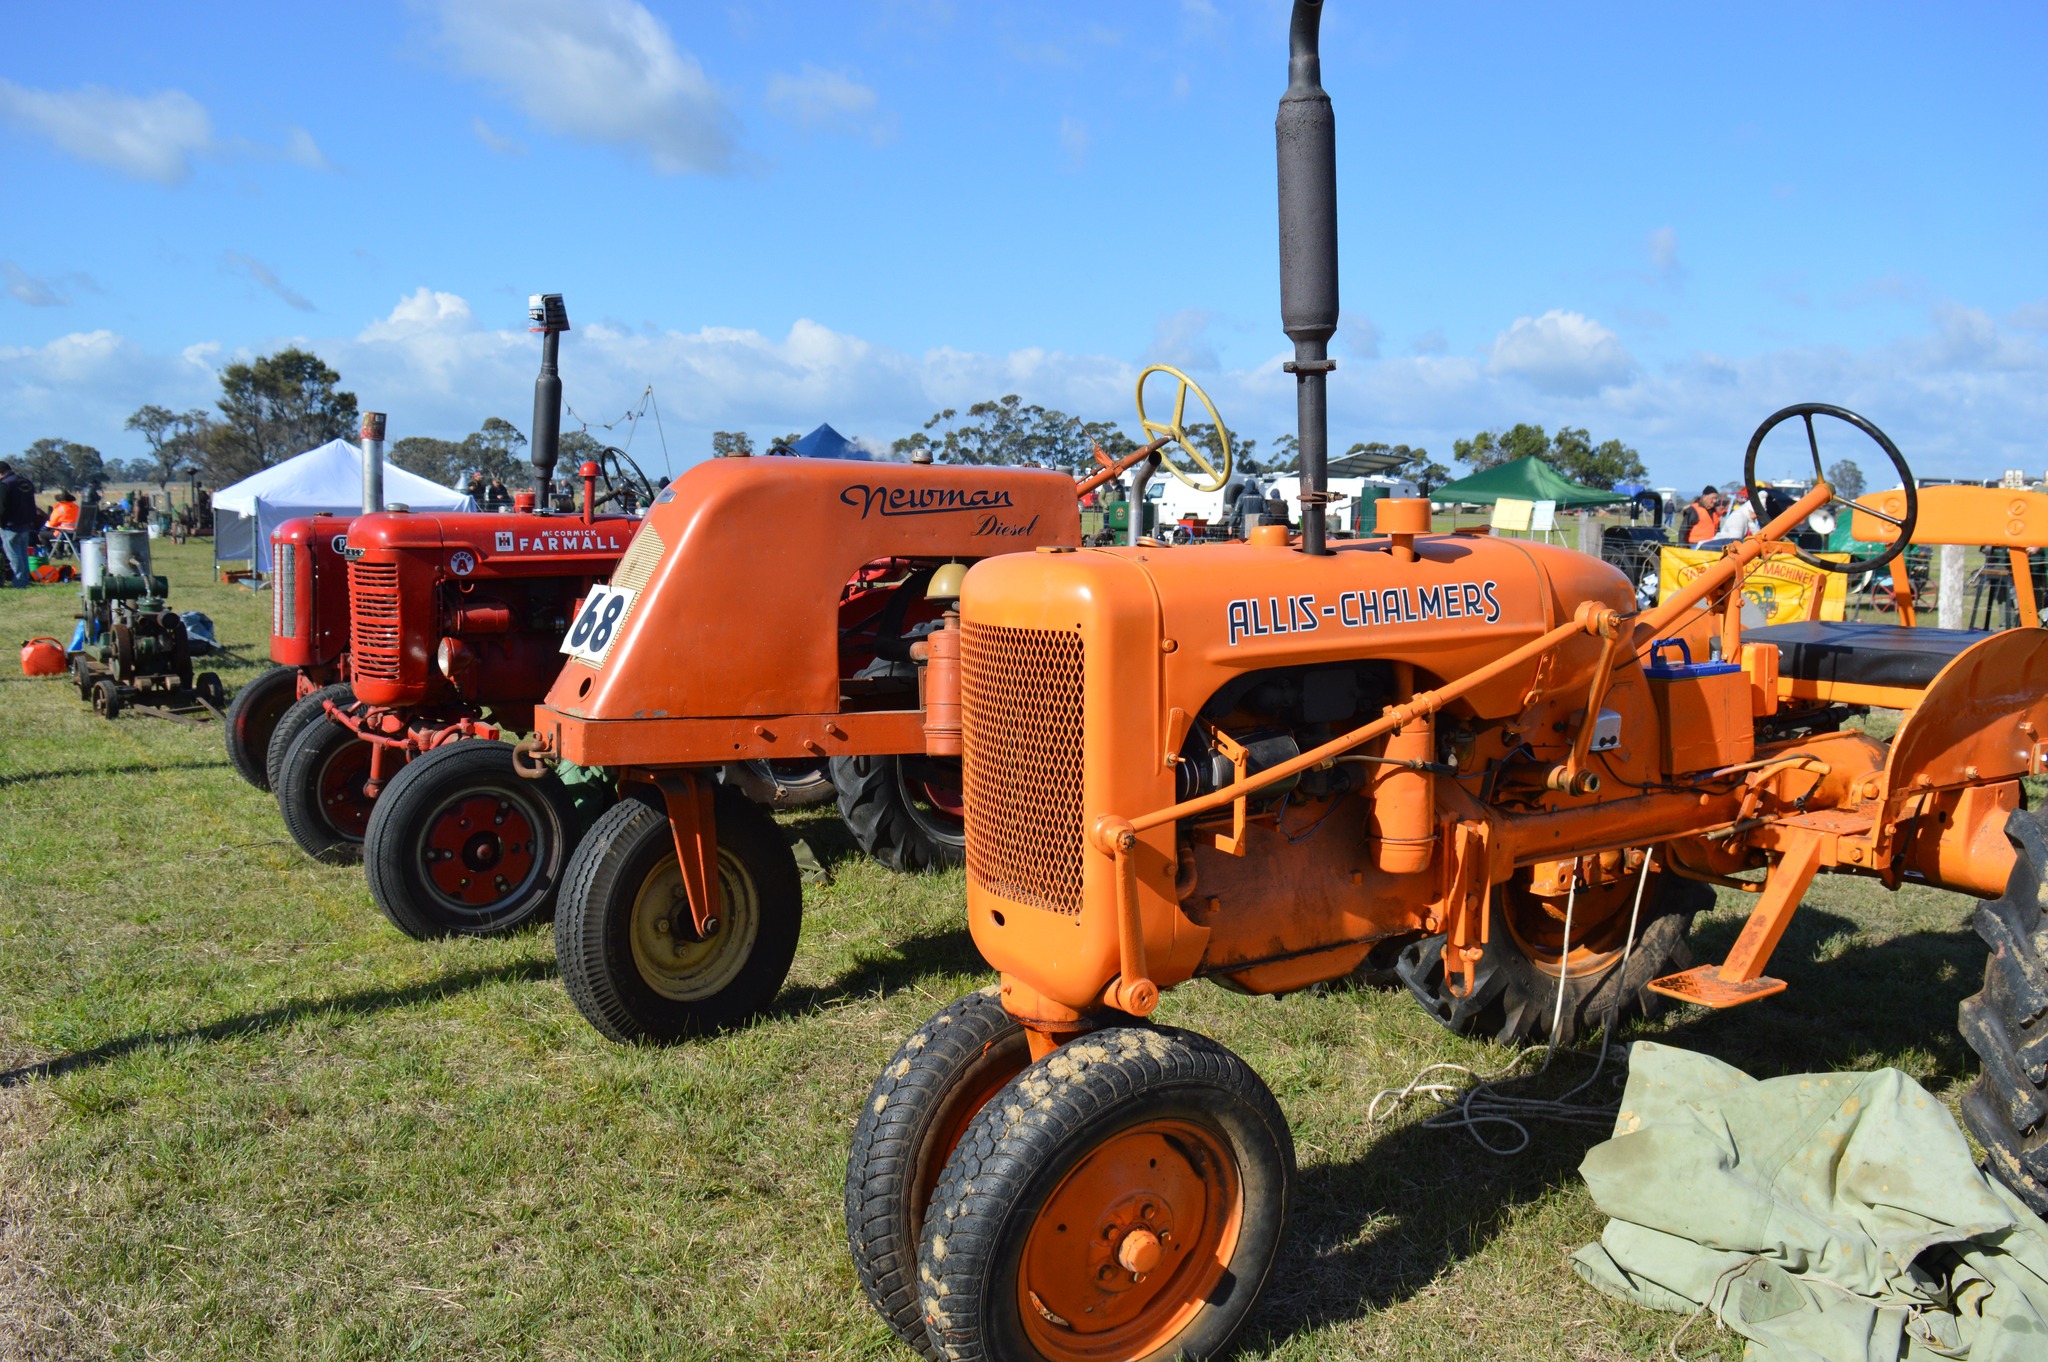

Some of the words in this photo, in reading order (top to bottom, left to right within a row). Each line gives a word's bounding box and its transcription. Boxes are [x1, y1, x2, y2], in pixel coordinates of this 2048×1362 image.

[840, 484, 1014, 520] Newman
[970, 513, 1040, 537] Diesel
[519, 536, 620, 551] FARMALL
[452, 552, 472, 563] SUPER
[456, 559, 469, 572] A
[1763, 562, 1816, 585] MACHINER
[571, 592, 625, 653] 68
[1227, 580, 1501, 646] ALLIS-CHALMERS
